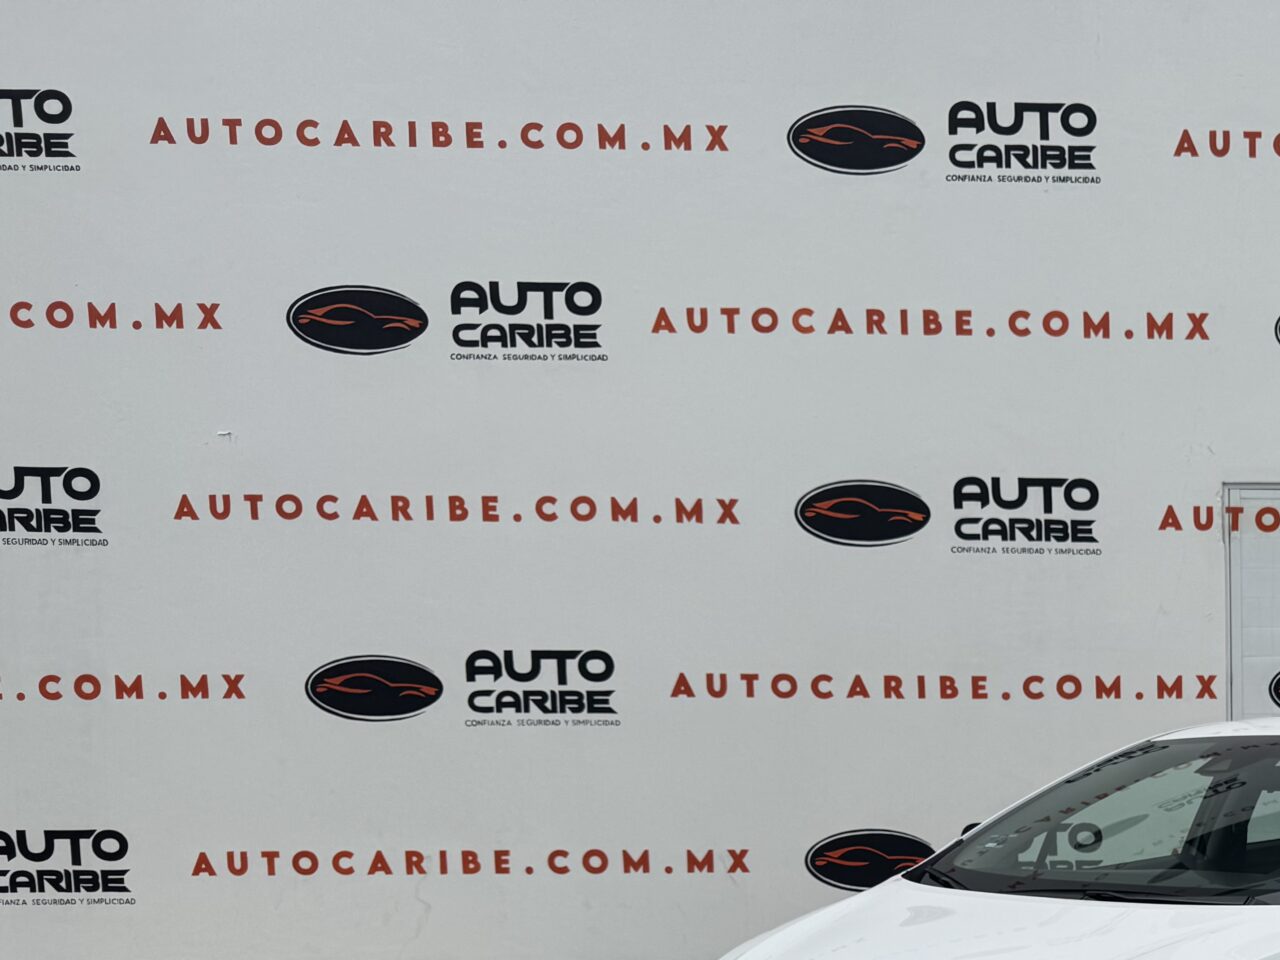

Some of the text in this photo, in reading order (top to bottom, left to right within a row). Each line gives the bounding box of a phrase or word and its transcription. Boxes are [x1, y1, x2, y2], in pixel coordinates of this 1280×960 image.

[151, 117, 729, 152] AUTOCARIBE.COM.MX
[947, 100, 1098, 142] AUTO
[0, 132, 77, 158] IBE
[947, 143, 1098, 171] CARIBE
[28, 164, 81, 172] SIMPLICIDAD
[945, 174, 993, 183] CONFIANZA
[996, 174, 1043, 183] SEGURIDAD
[1051, 173, 1102, 184] SIMPLICIDAD
[450, 280, 603, 321] AUTO
[451, 322, 602, 349] CARIBE
[651, 306, 1210, 341] AUTOCARIBE.COM.MX
[502, 353, 549, 361] SEGURIDAD
[557, 353, 609, 361] SIMPLICIDAD
[952, 476, 1100, 515] AUTO
[0, 508, 103, 534] RIBE
[174, 494, 740, 526] AUTOCARIBE.COM.MX
[1, 538, 49, 546] SEGURIDAD
[57, 536, 109, 547] SIMPLICIDAD
[953, 517, 1100, 544] CARIBE
[950, 546, 998, 554] CONFIANZA
[1001, 544, 1045, 555] SEGURIDAD
[1054, 548, 1103, 556] SIMPLICIDAD
[464, 649, 615, 686] AUTO
[0, 673, 246, 702] .COM.MX
[671, 671, 1218, 702] AUTOCARIBE.COM.MX
[467, 689, 618, 715] CARIBE
[464, 719, 512, 727] CONFIANZA
[191, 848, 750, 877] AUTOCARIBE.COM.MX
[31, 896, 77, 906] SEGURIDAD
[86, 896, 136, 905] SIMPLICIDAD
